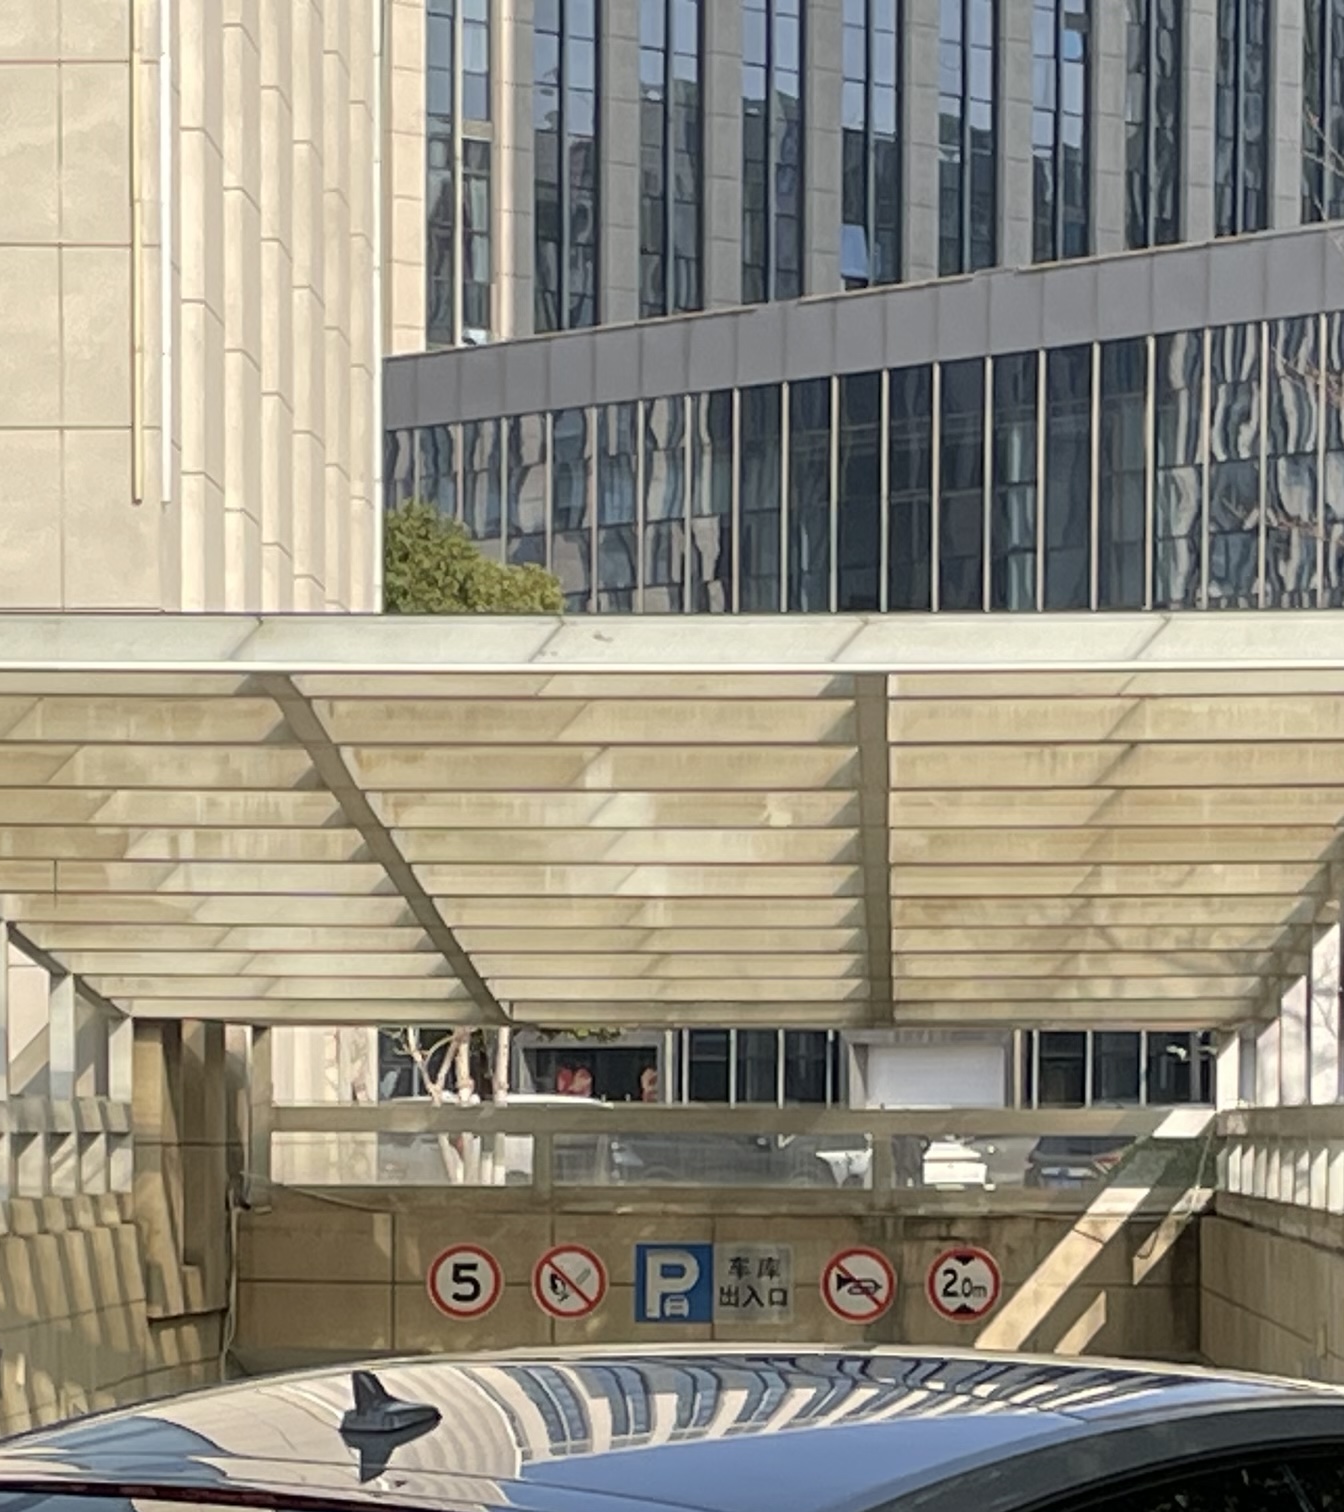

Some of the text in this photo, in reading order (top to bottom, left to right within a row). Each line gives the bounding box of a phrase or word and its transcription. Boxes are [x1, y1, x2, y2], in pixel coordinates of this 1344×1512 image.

[452, 1263, 481, 1302] 5
[728, 1256, 781, 1279] 车库
[646, 1251, 700, 1318] P
[719, 1285, 787, 1308] 出入口
